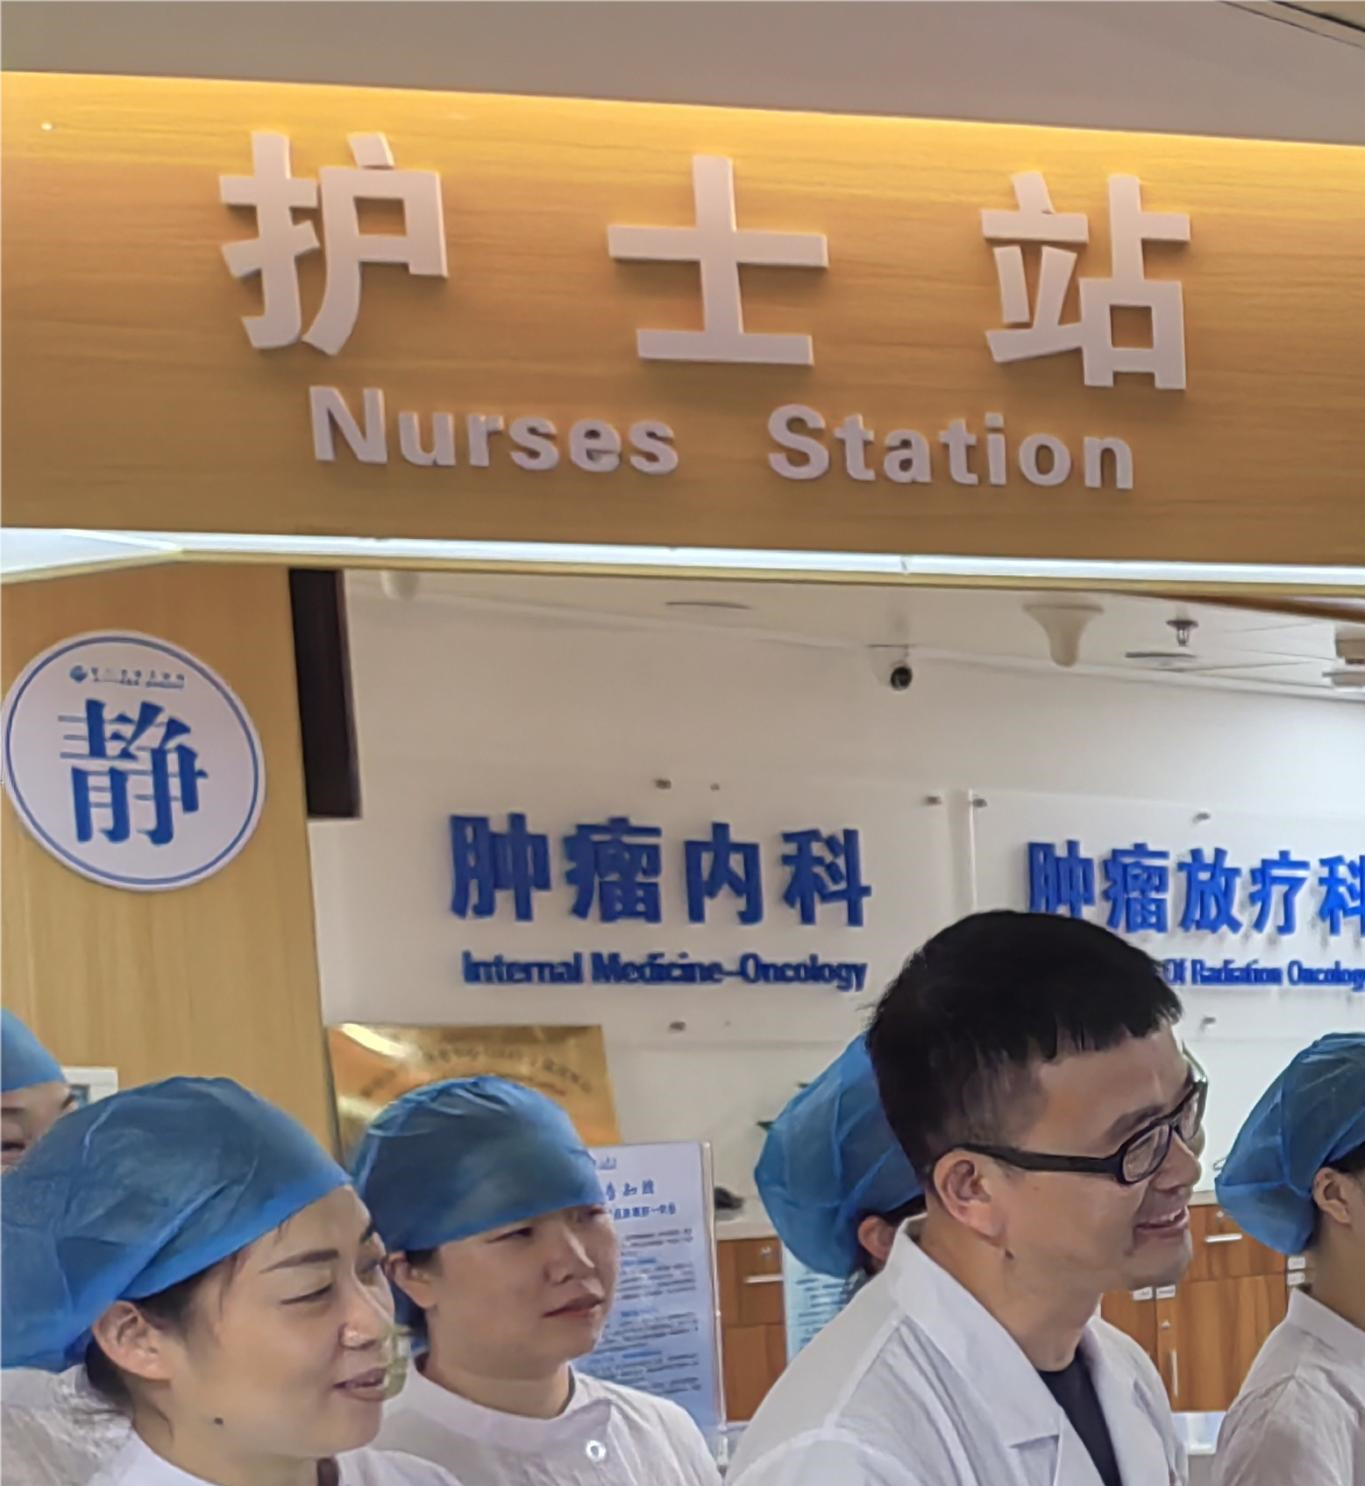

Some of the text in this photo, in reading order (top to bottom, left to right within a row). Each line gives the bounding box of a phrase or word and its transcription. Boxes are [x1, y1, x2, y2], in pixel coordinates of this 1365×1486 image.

[219, 130, 1192, 392] 护士站
[310, 385, 1134, 491] Nurses Station
[57, 698, 208, 845] 静
[449, 811, 872, 927] 肿瘤内科
[462, 950, 583, 985] Internal
[1163, 957, 1186, 985] Of
[1191, 958, 1283, 986] Radiation
